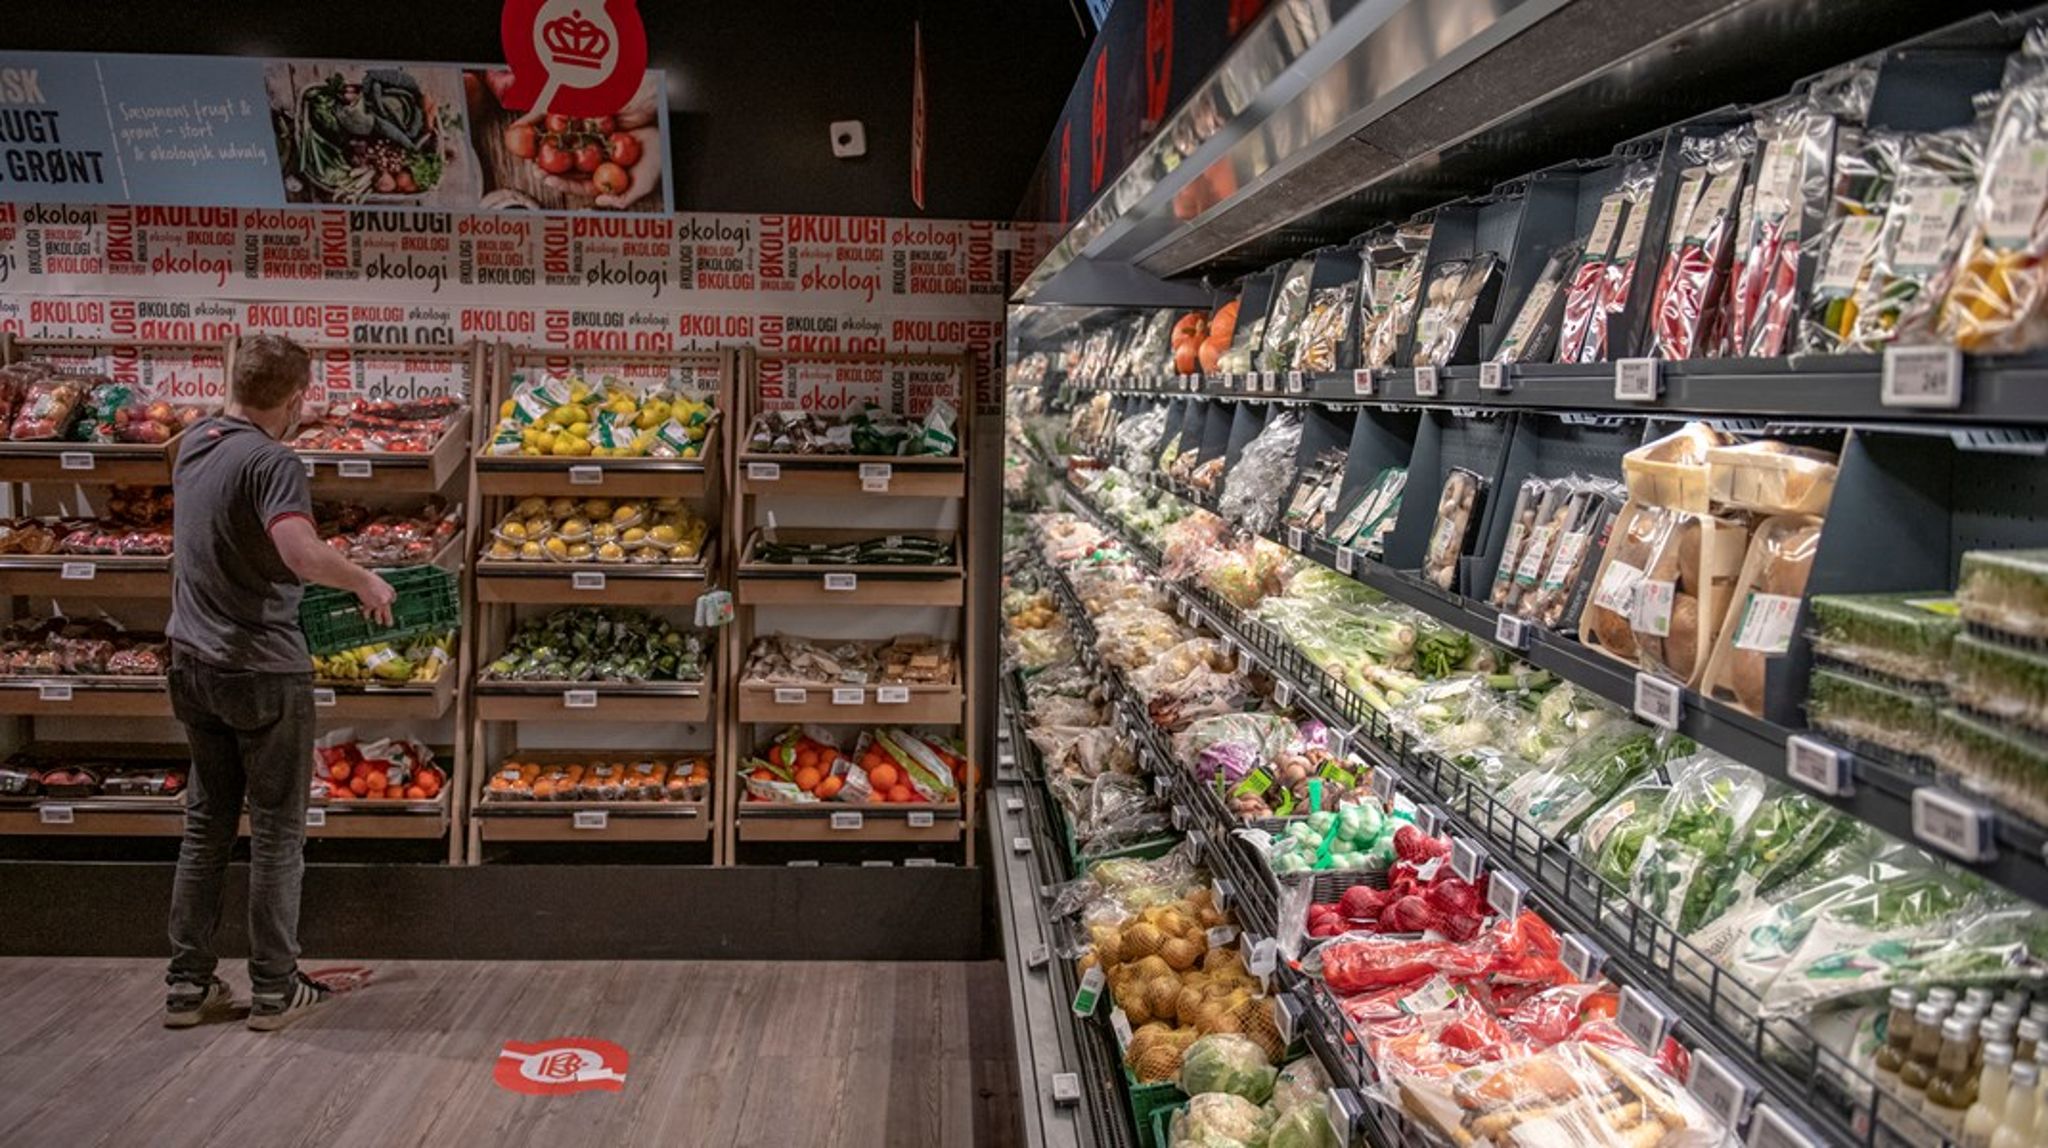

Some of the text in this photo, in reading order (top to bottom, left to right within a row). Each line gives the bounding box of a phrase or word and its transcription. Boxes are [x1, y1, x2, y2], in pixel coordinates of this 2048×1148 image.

[0, 68, 46, 104] SK
[119, 102, 189, 121] Sæsonens
[194, 100, 233, 124] frugt
[120, 125, 160, 145] grønt
[179, 123, 214, 138] stort
[150, 144, 214, 165] økologisk
[219, 142, 268, 165] udvalg
[10, 148, 104, 185] GRØNT
[24, 203, 98, 236] økologi
[244, 208, 316, 241] økologi
[187, 231, 236, 246] ØKOLOGI
[458, 214, 530, 246] økologi
[678, 217, 750, 251] økologi
[787, 215, 886, 244] ØKOLOGI
[401, 237, 450, 251] ØKOLOGI
[892, 222, 963, 257] økologi
[45, 242, 91, 256] ØKOLOGI
[263, 247, 311, 261] ØKOLOGI
[622, 243, 671, 257] ØKOLOGI
[836, 247, 884, 261] ØKOLOGI
[47, 258, 102, 275] ØKOLOGI
[152, 248, 233, 287] økologi
[476, 252, 524, 266] ØKOLOGI
[697, 258, 744, 272] ØKOLOGI
[263, 262, 323, 280] ØKOLOGI
[366, 253, 448, 293] økologi
[477, 268, 536, 285] ØKOLOGI
[910, 262, 956, 277] ØKOLOGI
[586, 260, 668, 298] økologi
[697, 273, 755, 290] ØKOLOGI
[801, 264, 882, 302] økologi
[910, 277, 968, 295] ØKOLOGI
[30, 302, 104, 323] ØKOLOGI
[138, 302, 190, 318] ØKOLOGI
[194, 303, 236, 321] økologi
[248, 304, 322, 327] ØKOLOGI
[352, 306, 404, 322] ØKOLOGI
[409, 307, 451, 325] økologi
[572, 311, 624, 327] ØKOLOGI
[461, 310, 535, 332] ØKOLOGI
[629, 313, 669, 331] økologi
[680, 314, 754, 336] ØKOLOGI
[787, 316, 837, 332] ØKOLOGI
[842, 317, 883, 335] økologi
[893, 320, 965, 342] ØKOLOGI
[405, 358, 453, 373] ØKOLOGI
[624, 363, 671, 378] ØKOLOGI
[836, 368, 883, 383] ØKOLOGI
[909, 384, 953, 397] ØKOLOGI
